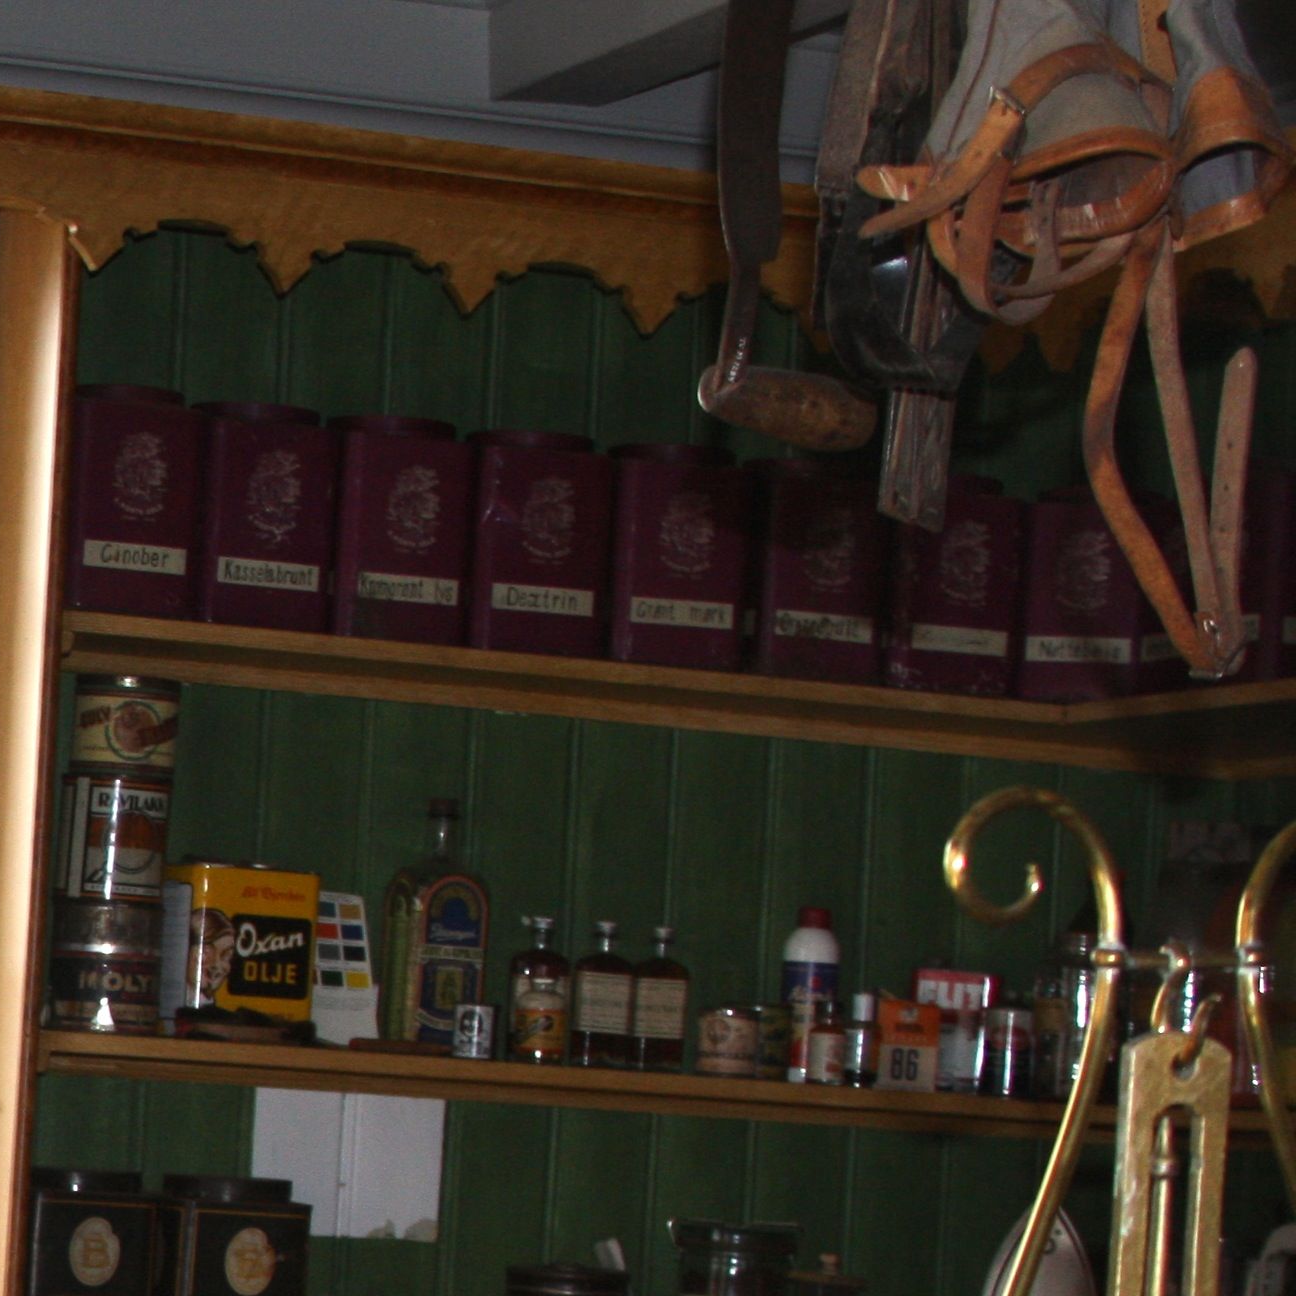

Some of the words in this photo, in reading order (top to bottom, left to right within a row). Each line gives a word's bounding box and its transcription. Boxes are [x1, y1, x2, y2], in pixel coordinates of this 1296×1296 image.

[235, 921, 305, 958] Oxan
[243, 959, 299, 986] OLJE
[890, 1046, 920, 1082] 86
